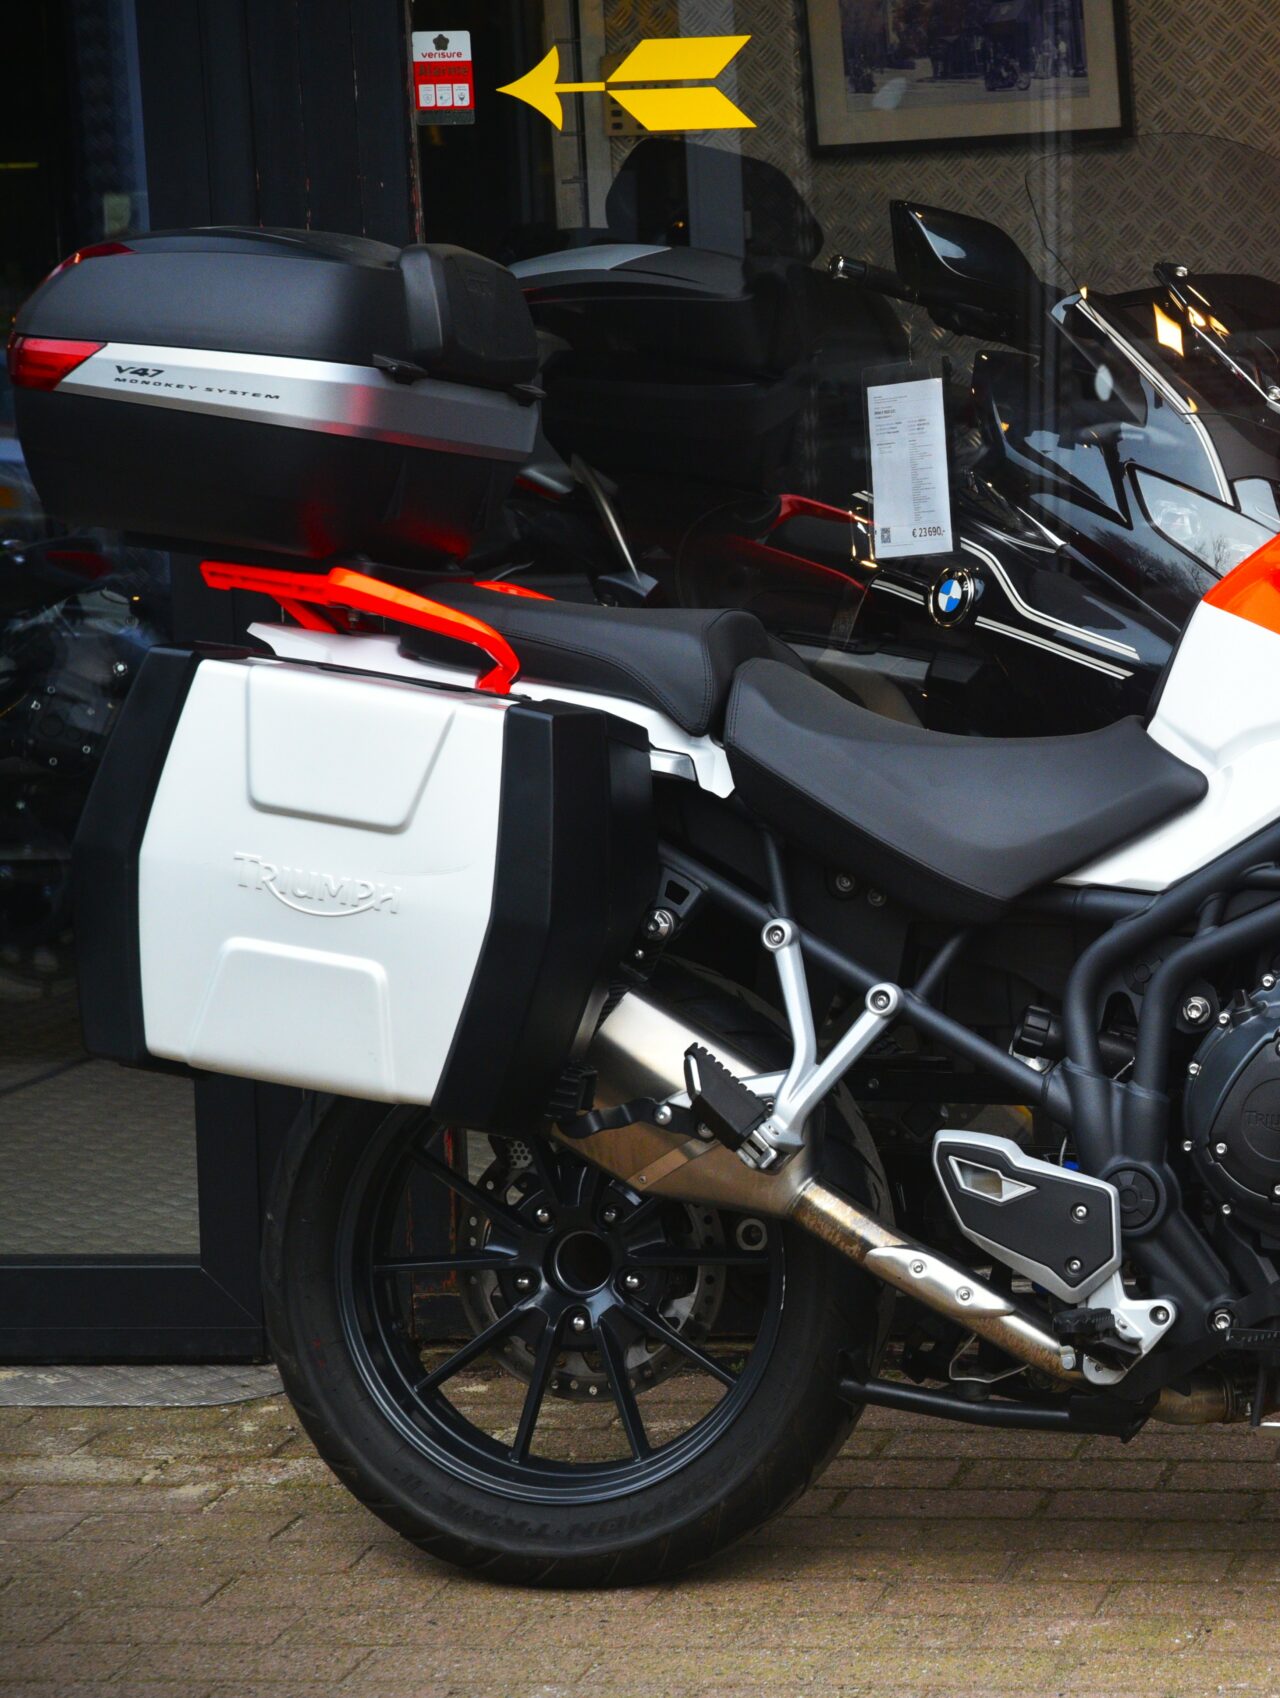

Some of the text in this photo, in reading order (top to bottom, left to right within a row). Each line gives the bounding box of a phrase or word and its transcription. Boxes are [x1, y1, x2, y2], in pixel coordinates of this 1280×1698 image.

[421, 51, 462, 59] verisure
[115, 365, 165, 378] V47
[114, 377, 281, 400] MONOKEY SYSTEM
[912, 528, 917, 538] €
[233, 851, 402, 917] TRIUMPH
